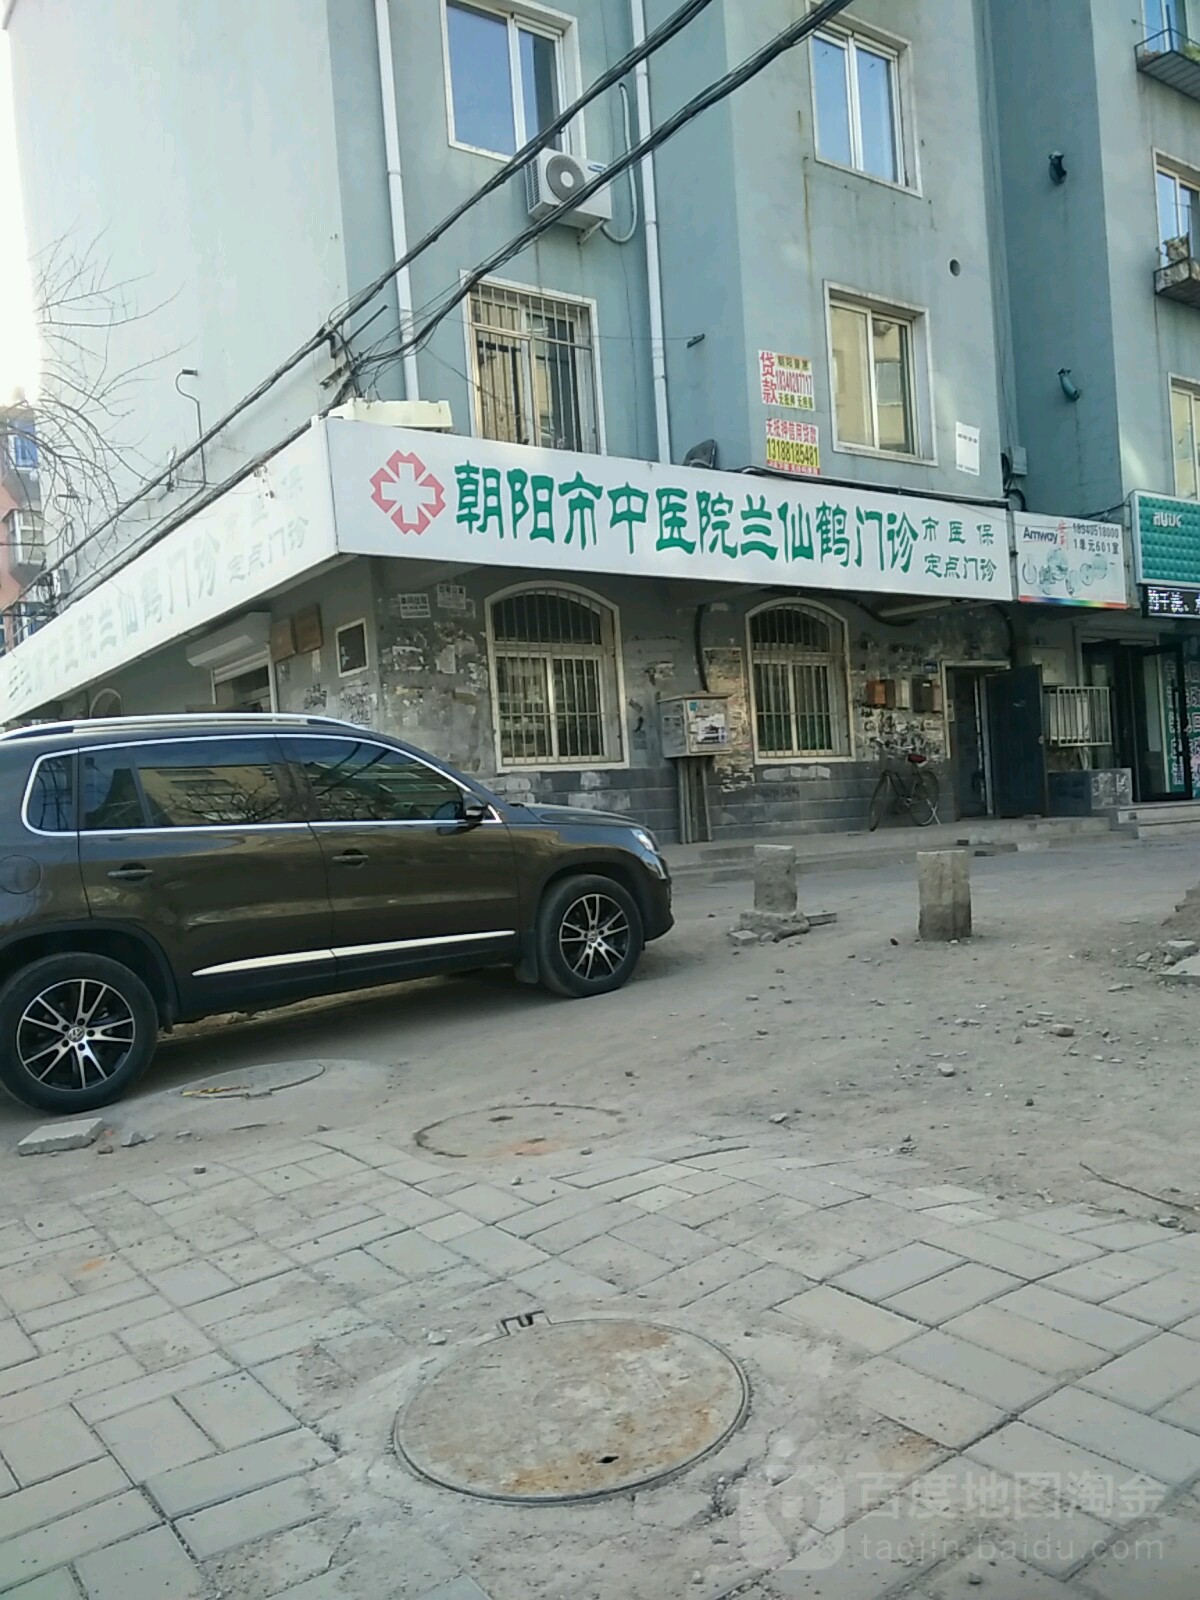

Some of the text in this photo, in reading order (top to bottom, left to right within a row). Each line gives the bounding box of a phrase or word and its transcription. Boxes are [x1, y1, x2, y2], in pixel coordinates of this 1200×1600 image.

[760, 351, 778, 404] 贷款
[767, 437, 818, 467] 13188185481
[454, 459, 920, 574] 朝阳市中医院兰仙鹤门诊
[227, 515, 310, 584] 定点门诊
[1023, 526, 1058, 545] Amway
[1073, 538, 1120, 555] 1单元601室
[924, 554, 998, 583] 定点门诊
